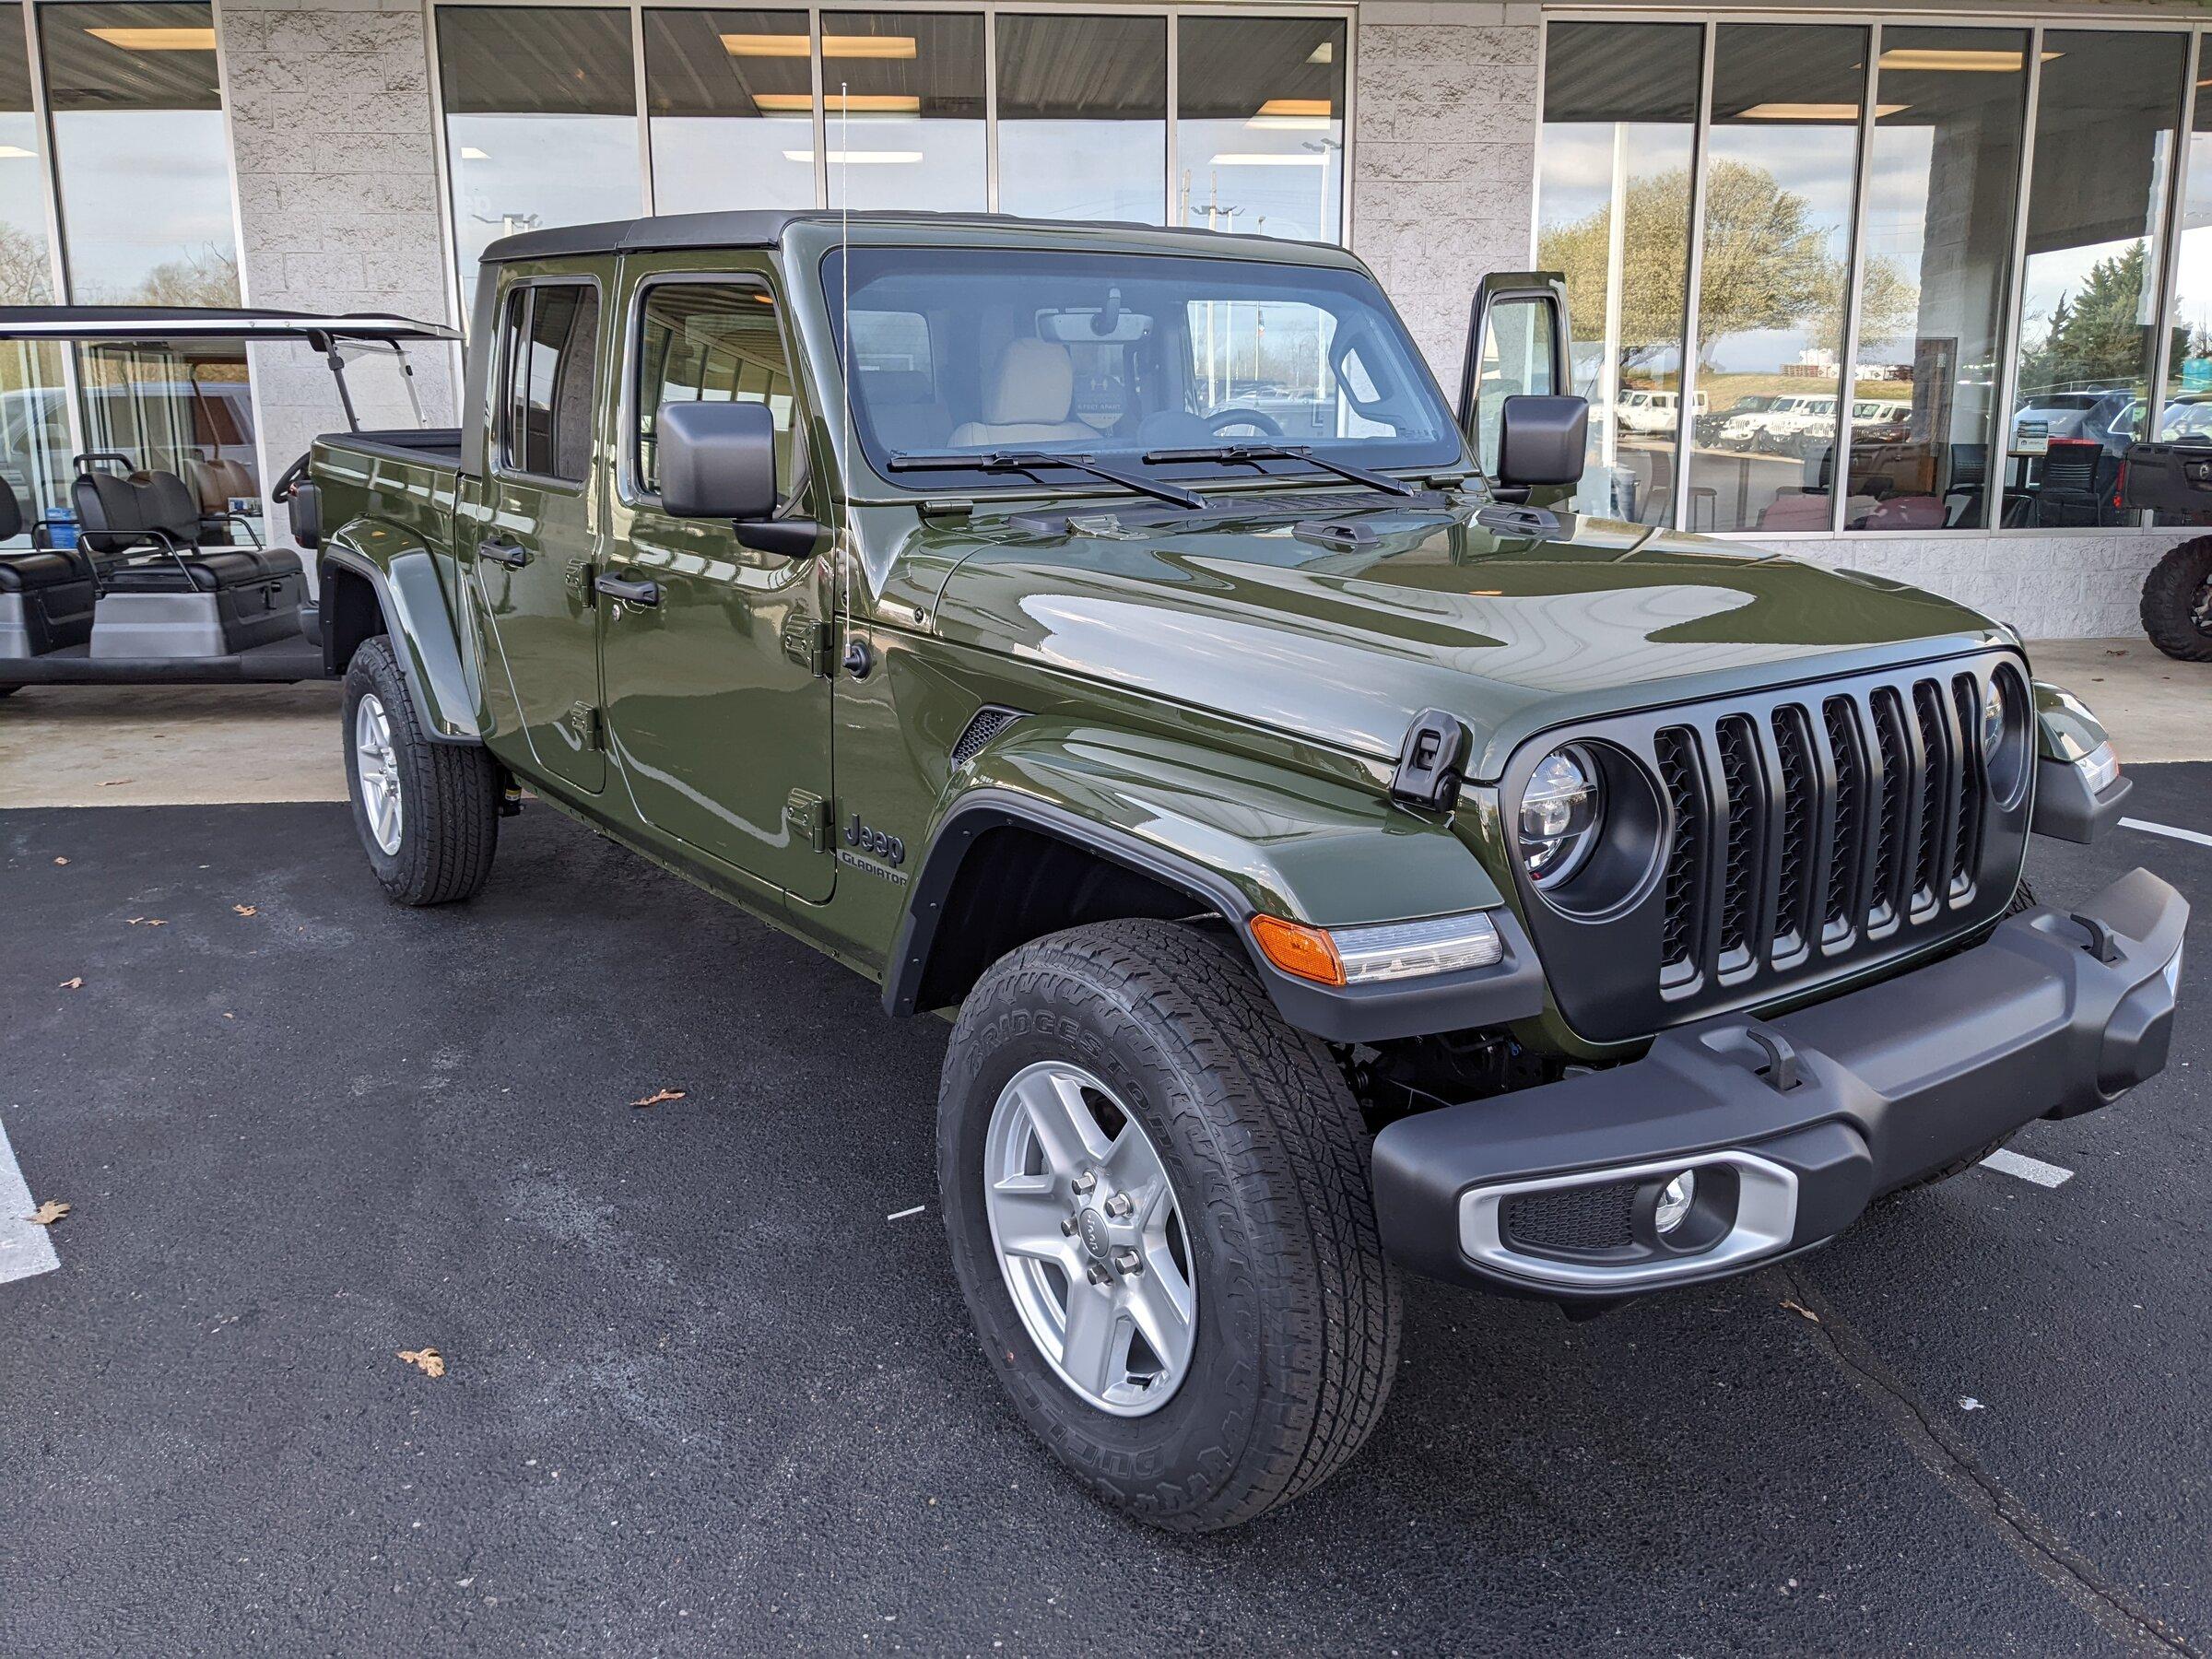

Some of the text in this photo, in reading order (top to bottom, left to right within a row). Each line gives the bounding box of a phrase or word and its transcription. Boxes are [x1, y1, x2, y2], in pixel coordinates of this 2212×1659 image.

[842, 813, 905, 868] Jeep
[841, 852, 908, 887] GLADIATOR
[966, 1007, 1194, 1189] BRIDGESTONE
